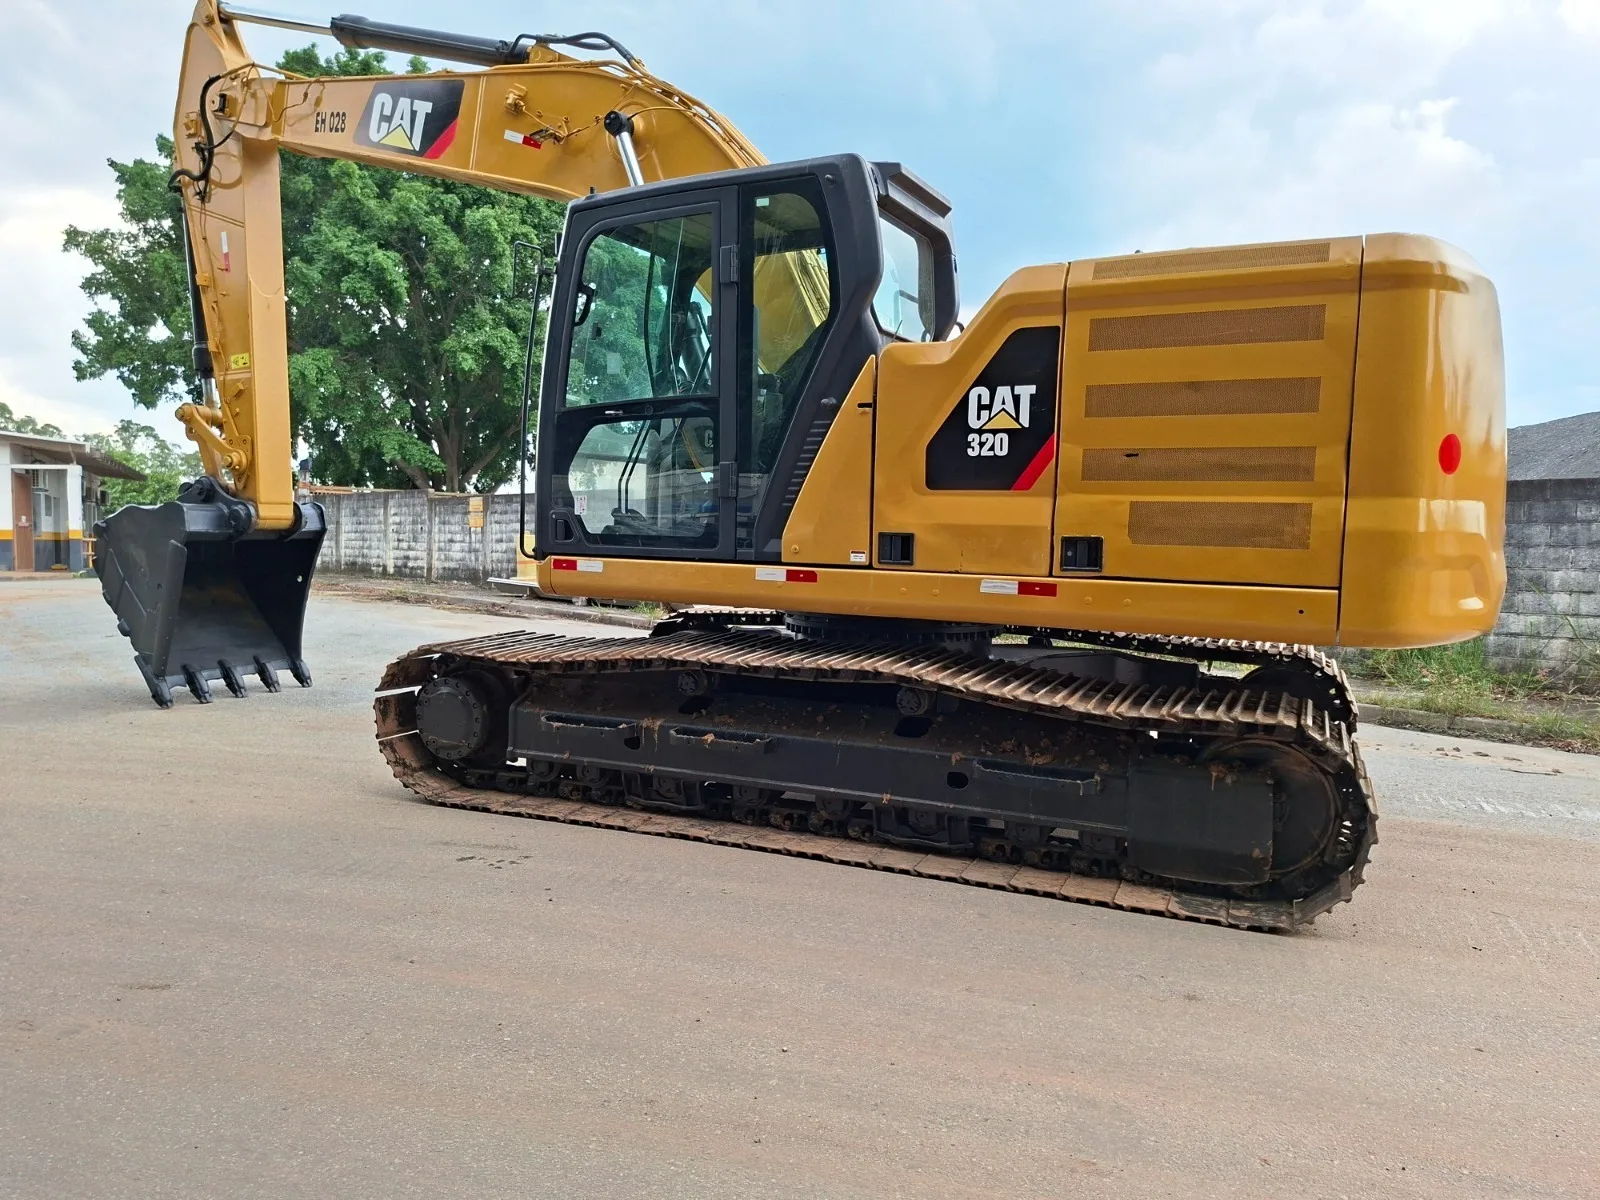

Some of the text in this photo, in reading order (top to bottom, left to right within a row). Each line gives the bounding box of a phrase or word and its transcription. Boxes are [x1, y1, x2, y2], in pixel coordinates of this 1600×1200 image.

[314, 111, 347, 133] EH 028
[368, 92, 433, 151] CAT
[967, 384, 1037, 430] CAT
[966, 432, 1009, 457] 320
